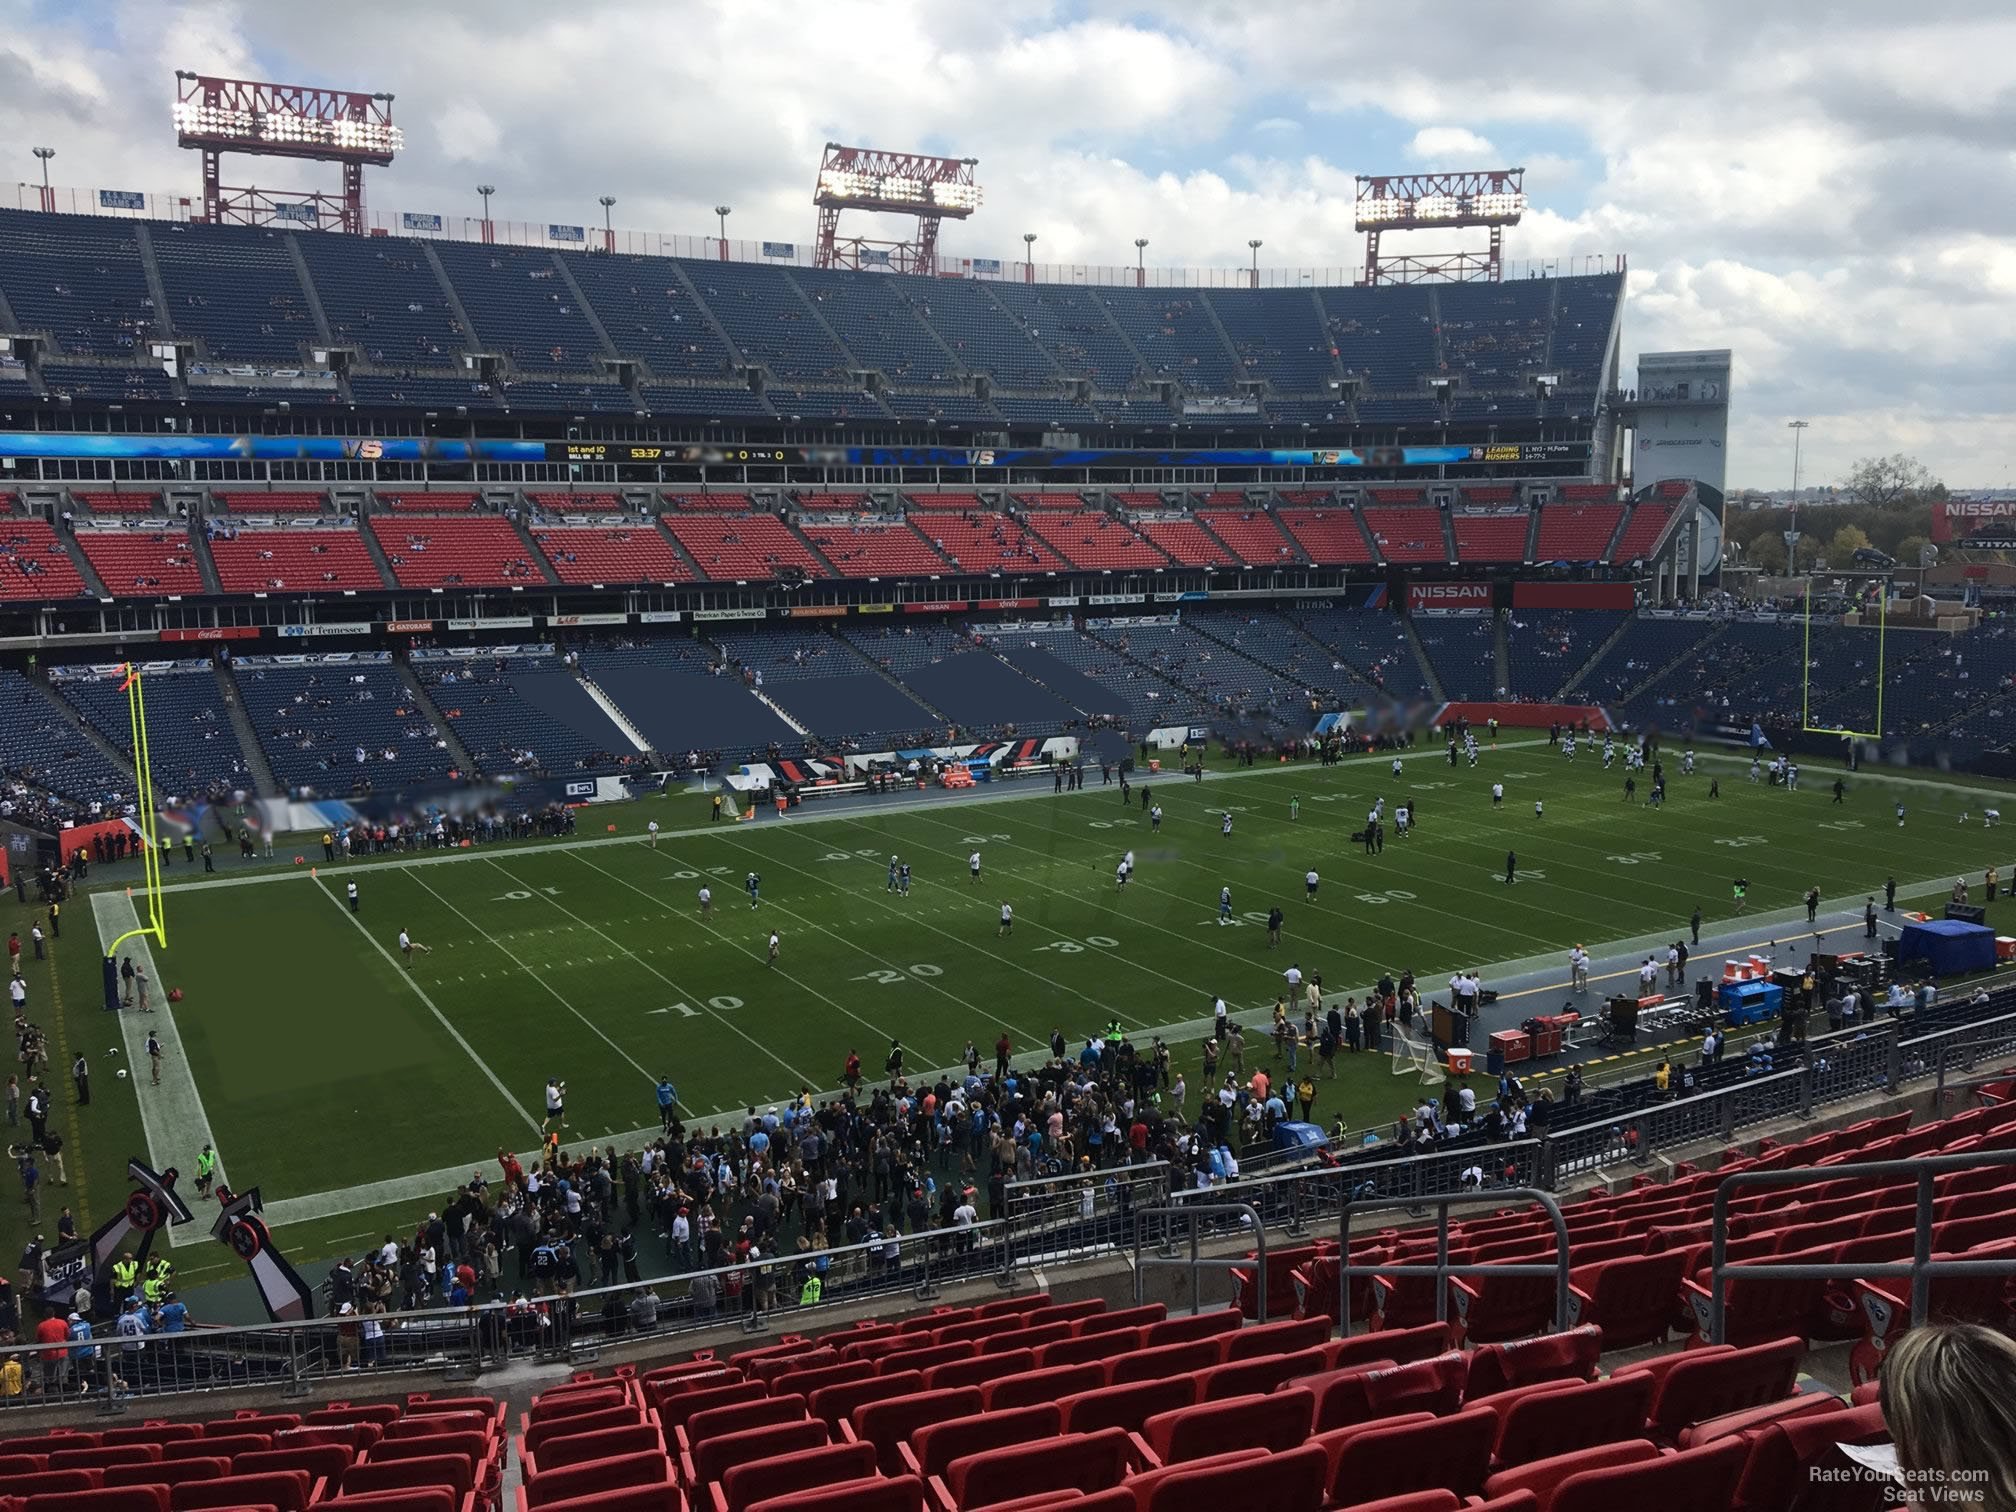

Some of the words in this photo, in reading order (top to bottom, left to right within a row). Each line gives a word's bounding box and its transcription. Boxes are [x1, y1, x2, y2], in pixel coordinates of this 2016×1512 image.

[406, 220, 440, 230] BLANDA
[631, 449, 661, 458] 53:37
[966, 450, 995, 465] VS
[1412, 586, 1487, 598] NISSAN
[304, 627, 314, 635] of
[317, 624, 365, 635] Tennessee
[1354, 889, 1417, 904] 50
[1050, 936, 1119, 953] 30
[866, 964, 944, 984] 20
[668, 995, 744, 1018] 10
[1456, 1058, 1467, 1070] G
[537, 1255, 548, 1266] 22
